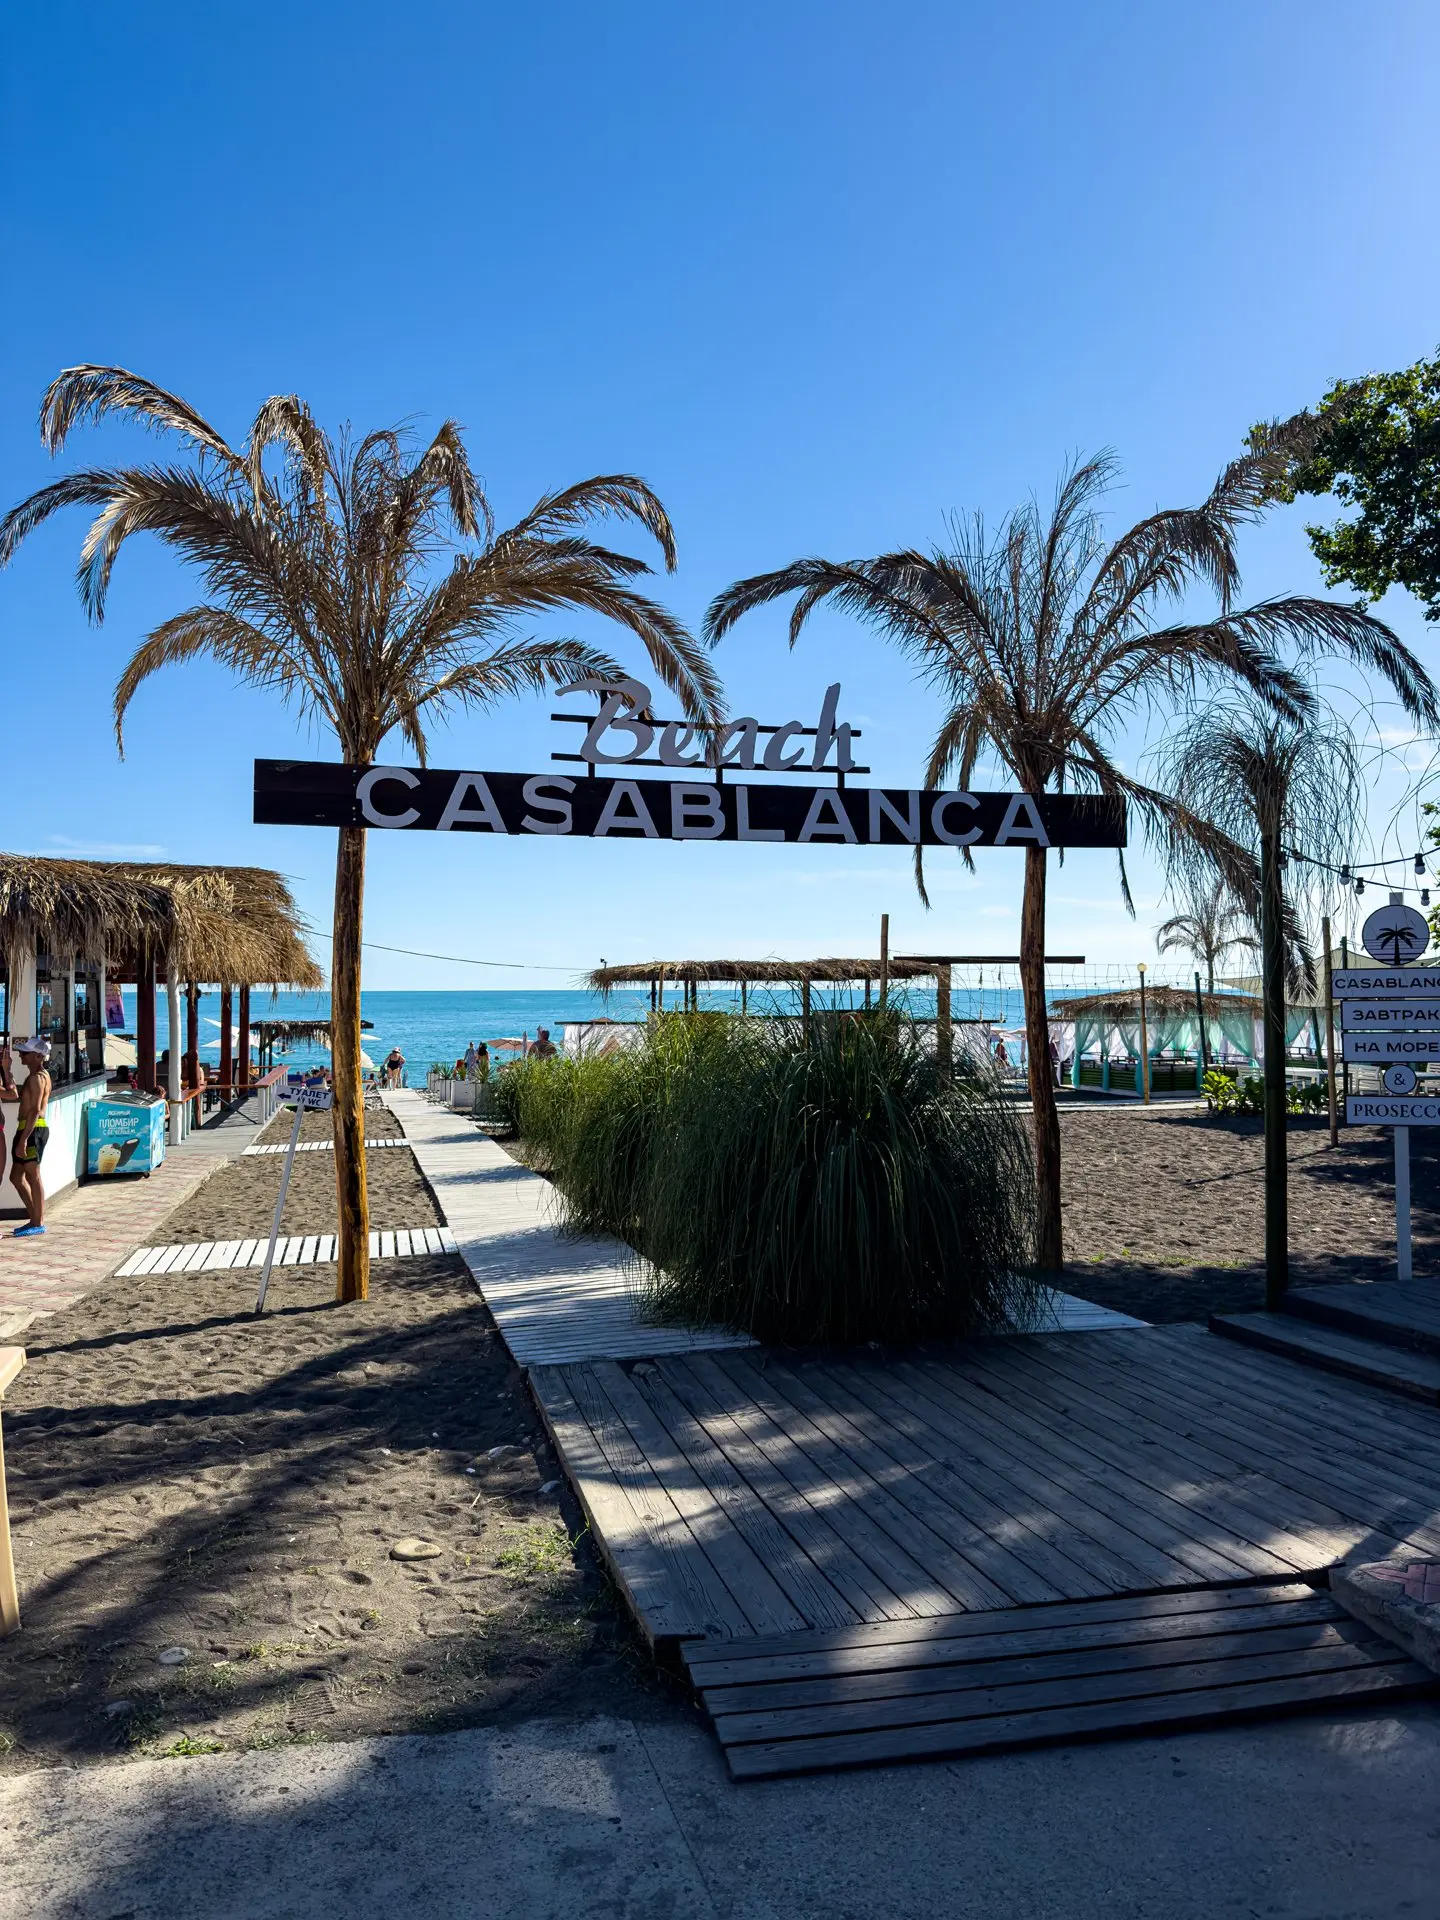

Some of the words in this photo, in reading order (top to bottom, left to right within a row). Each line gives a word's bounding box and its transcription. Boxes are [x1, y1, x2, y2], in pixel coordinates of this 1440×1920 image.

[554, 677, 856, 772] Beach
[356, 766, 1050, 847] CASABLANCA
[1334, 977, 1440, 989] CASABLAN
[1352, 1009, 1440, 1021] ЗАВТРАК
[1354, 1042, 1380, 1053] НА
[1386, 1042, 1440, 1053] МОРЕ
[1393, 1072, 1406, 1086] &
[290, 1087, 329, 1099] ТУАЛЕТ
[308, 1098, 321, 1107] WC
[1353, 1103, 1440, 1118] PROSECC
[99, 1117, 139, 1128] ПЛОМБИР
